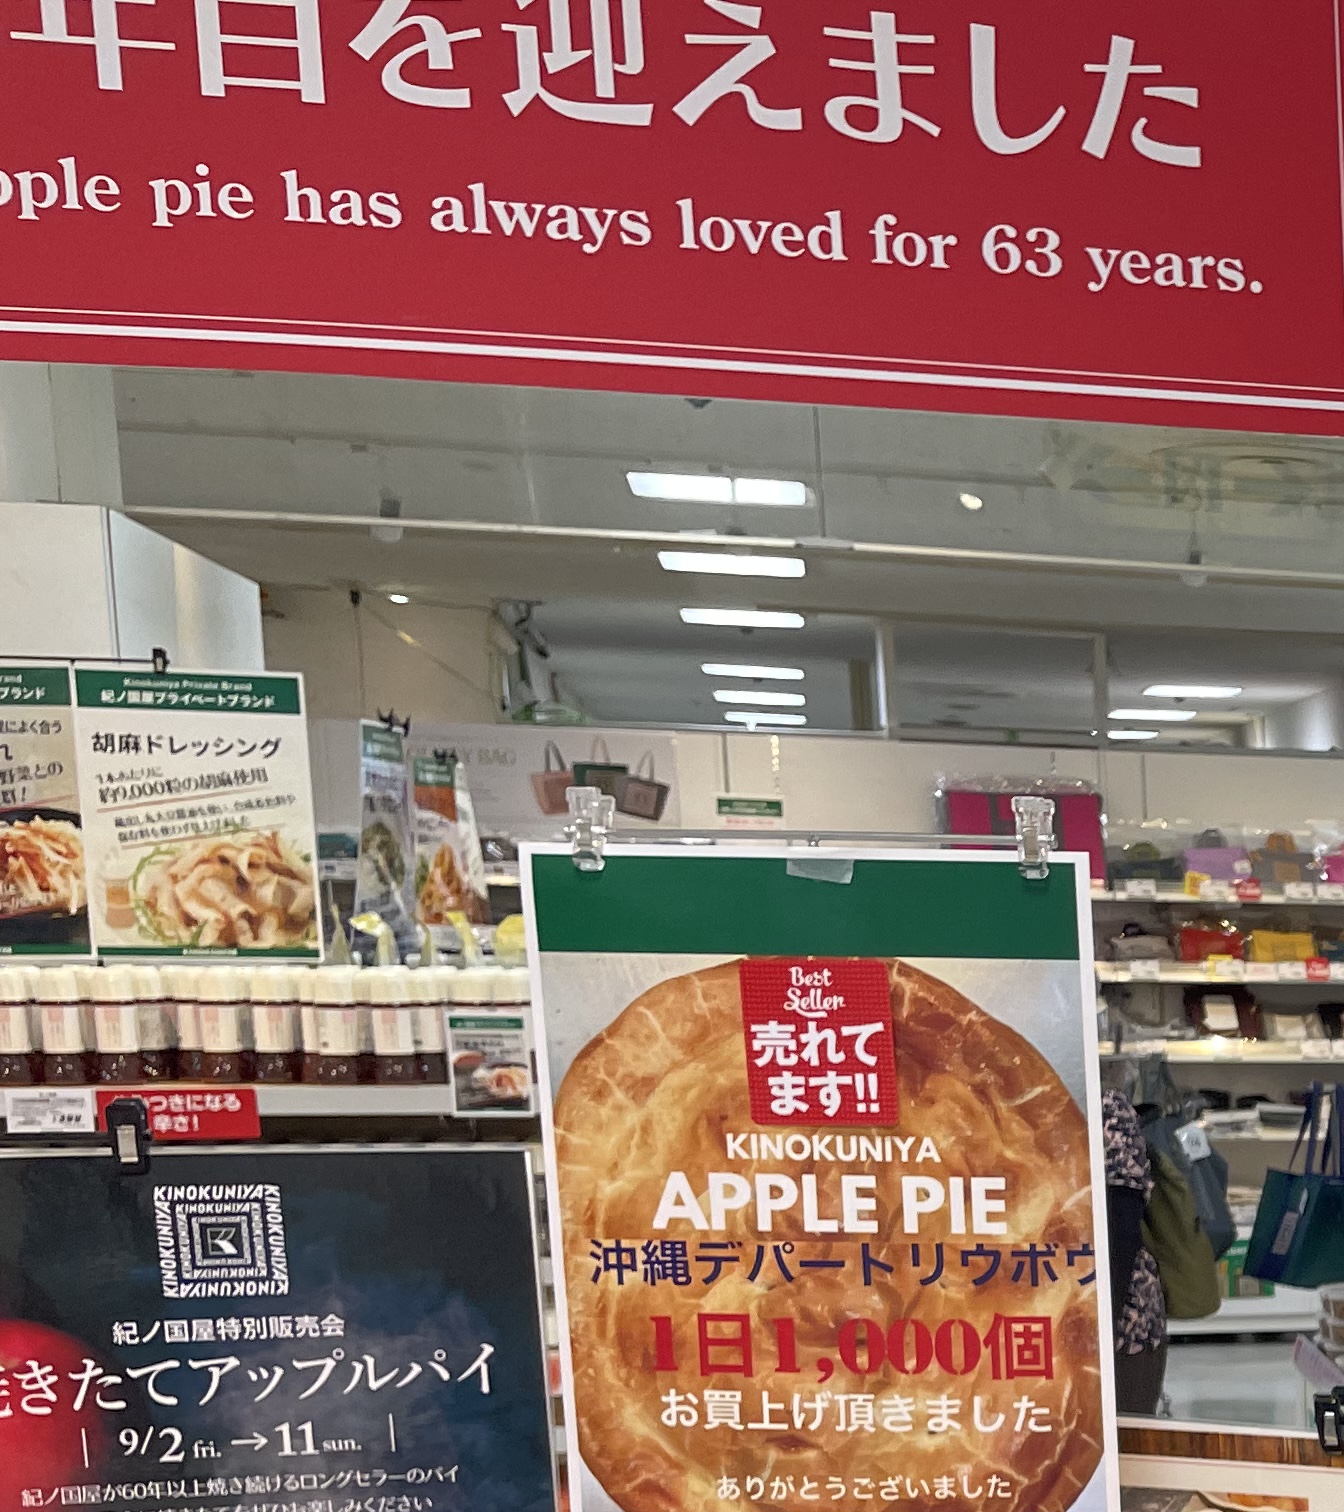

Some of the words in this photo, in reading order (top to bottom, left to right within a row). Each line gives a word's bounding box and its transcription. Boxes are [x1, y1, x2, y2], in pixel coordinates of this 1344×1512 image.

[0, 156, 121, 220] ple
[150, 163, 254, 226] pie
[280, 169, 402, 228] has
[430, 183, 651, 253] always
[679, 199, 846, 261] loved
[870, 214, 956, 269] for
[981, 224, 1063, 278] 63
[1087, 242, 1263, 293] years.
[91, 731, 282, 759] 胡麻ドレッシング
[789, 965, 832, 987] Best
[783, 987, 846, 1017] Seller
[750, 1020, 884, 1068] 売れて
[768, 1070, 881, 1116] ます!!
[726, 1132, 941, 1163] KINOKUNIYA
[153, 1184, 264, 1201] KINOKUNIYA
[653, 1171, 879, 1234] APPLE
[902, 1175, 1008, 1235] PIE
[588, 1238, 1096, 1287] 沖縄デパートリウボウ
[112, 1313, 346, 1346] 紀ノ国屋特別販売会
[648, 1313, 1055, 1383] 1日1,000個
[0, 1342, 496, 1421] きたてアップルパイ
[659, 1388, 1053, 1434] お買上げ頂きました
[118, 1426, 185, 1464] 9/2
[192, 1439, 221, 1460] fri.
[276, 1420, 321, 1458] 11
[322, 1434, 363, 1452] sun.
[21, 1464, 459, 1508] 紀ノ国屋が60年以上焼き続けるロングセラーのパイ
[716, 1475, 1012, 1502] ありがとうございました
